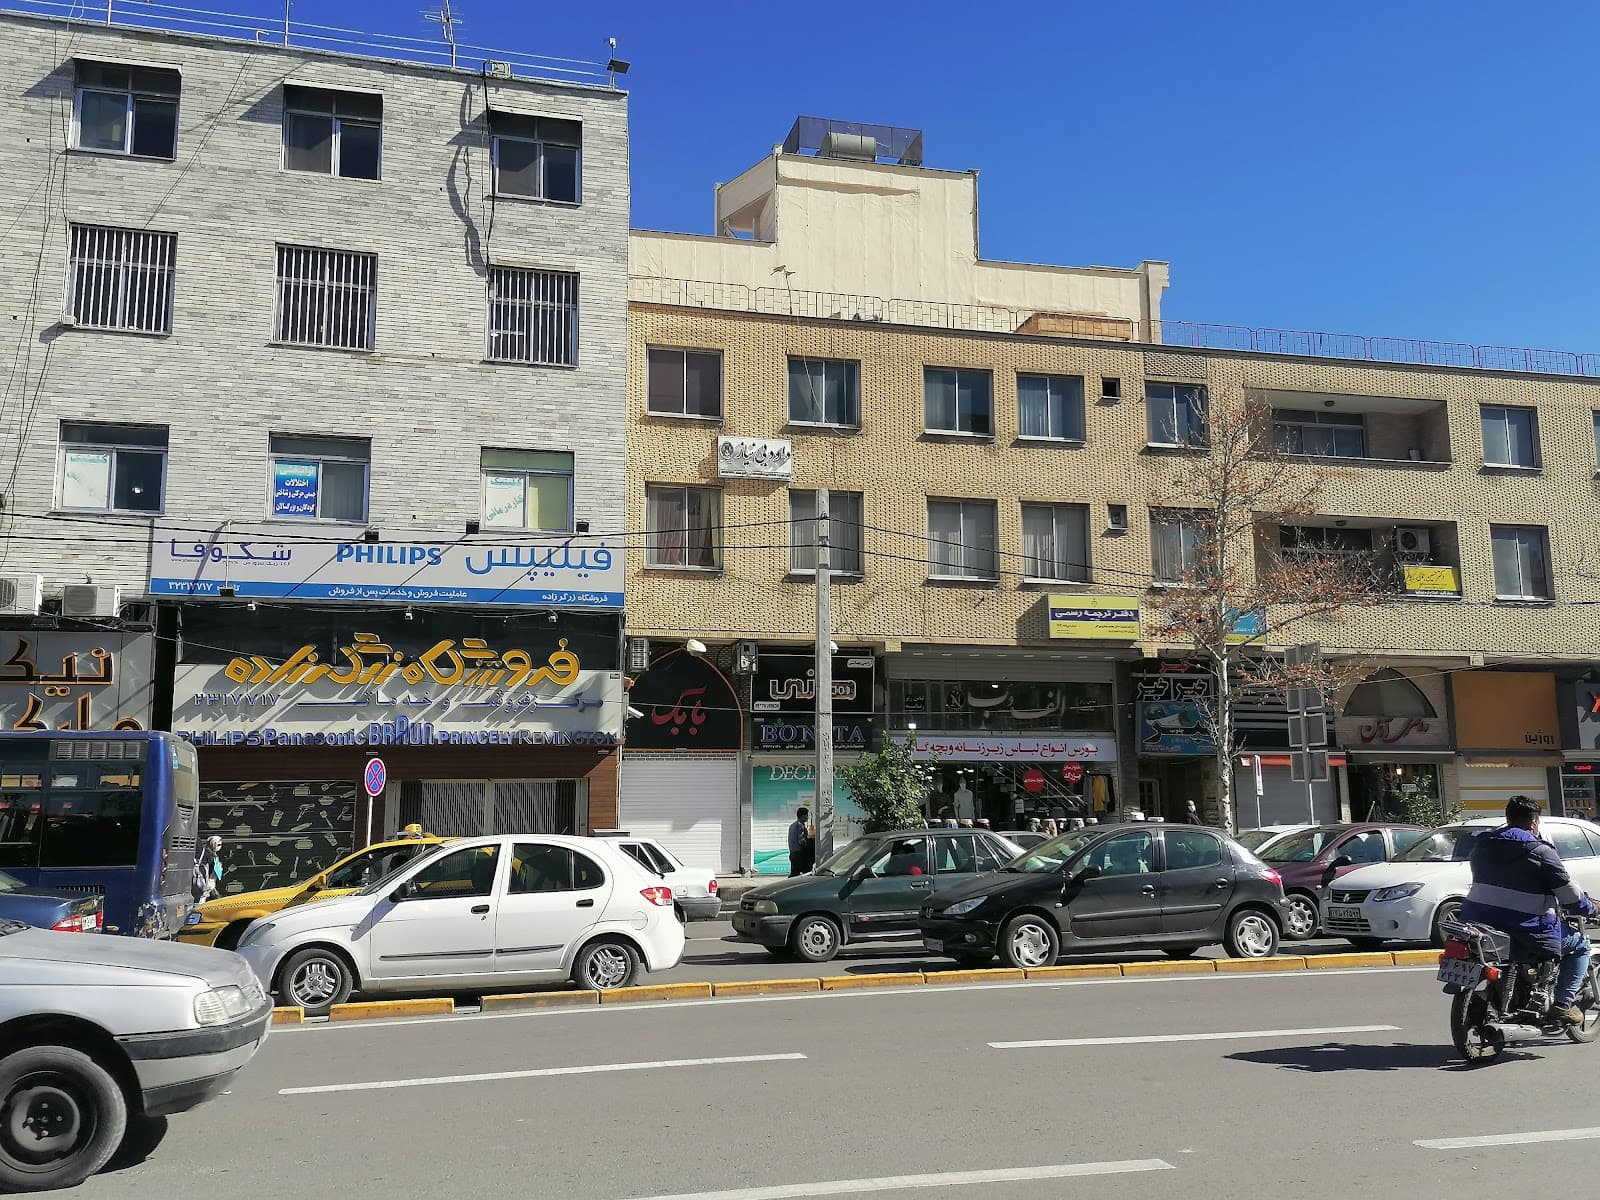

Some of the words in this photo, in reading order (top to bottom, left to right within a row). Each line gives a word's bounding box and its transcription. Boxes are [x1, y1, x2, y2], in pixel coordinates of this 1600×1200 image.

[170, 538, 292, 563] شکوفا
[337, 543, 442, 567] PHILIPS
[465, 541, 613, 583] فیلیپس
[328, 586, 355, 596] فروش
[362, 589, 378, 598] پس
[378, 587, 407, 596] خدمات
[413, 588, 438, 599] فروش
[439, 590, 467, 599] عاملیت
[577, 592, 608, 604] فروشگاه
[1055, 609, 1083, 618] رسمی
[1083, 610, 1112, 618] ترجمه
[1112, 609, 1134, 618] دفتر
[401, 638, 581, 687] فروشگاه
[176, 731, 262, 746] PHILIPS
[263, 729, 367, 747] Panasonic
[437, 730, 518, 746] PRINCELY
[518, 729, 618, 745] REMINGTON
[760, 724, 867, 743] BONTA
[955, 742, 986, 757] زنانه
[984, 742, 1004, 757] زیر
[1004, 742, 1039, 757] لباس
[1040, 742, 1067, 758] انواع
[1067, 742, 1099, 757] بورس
